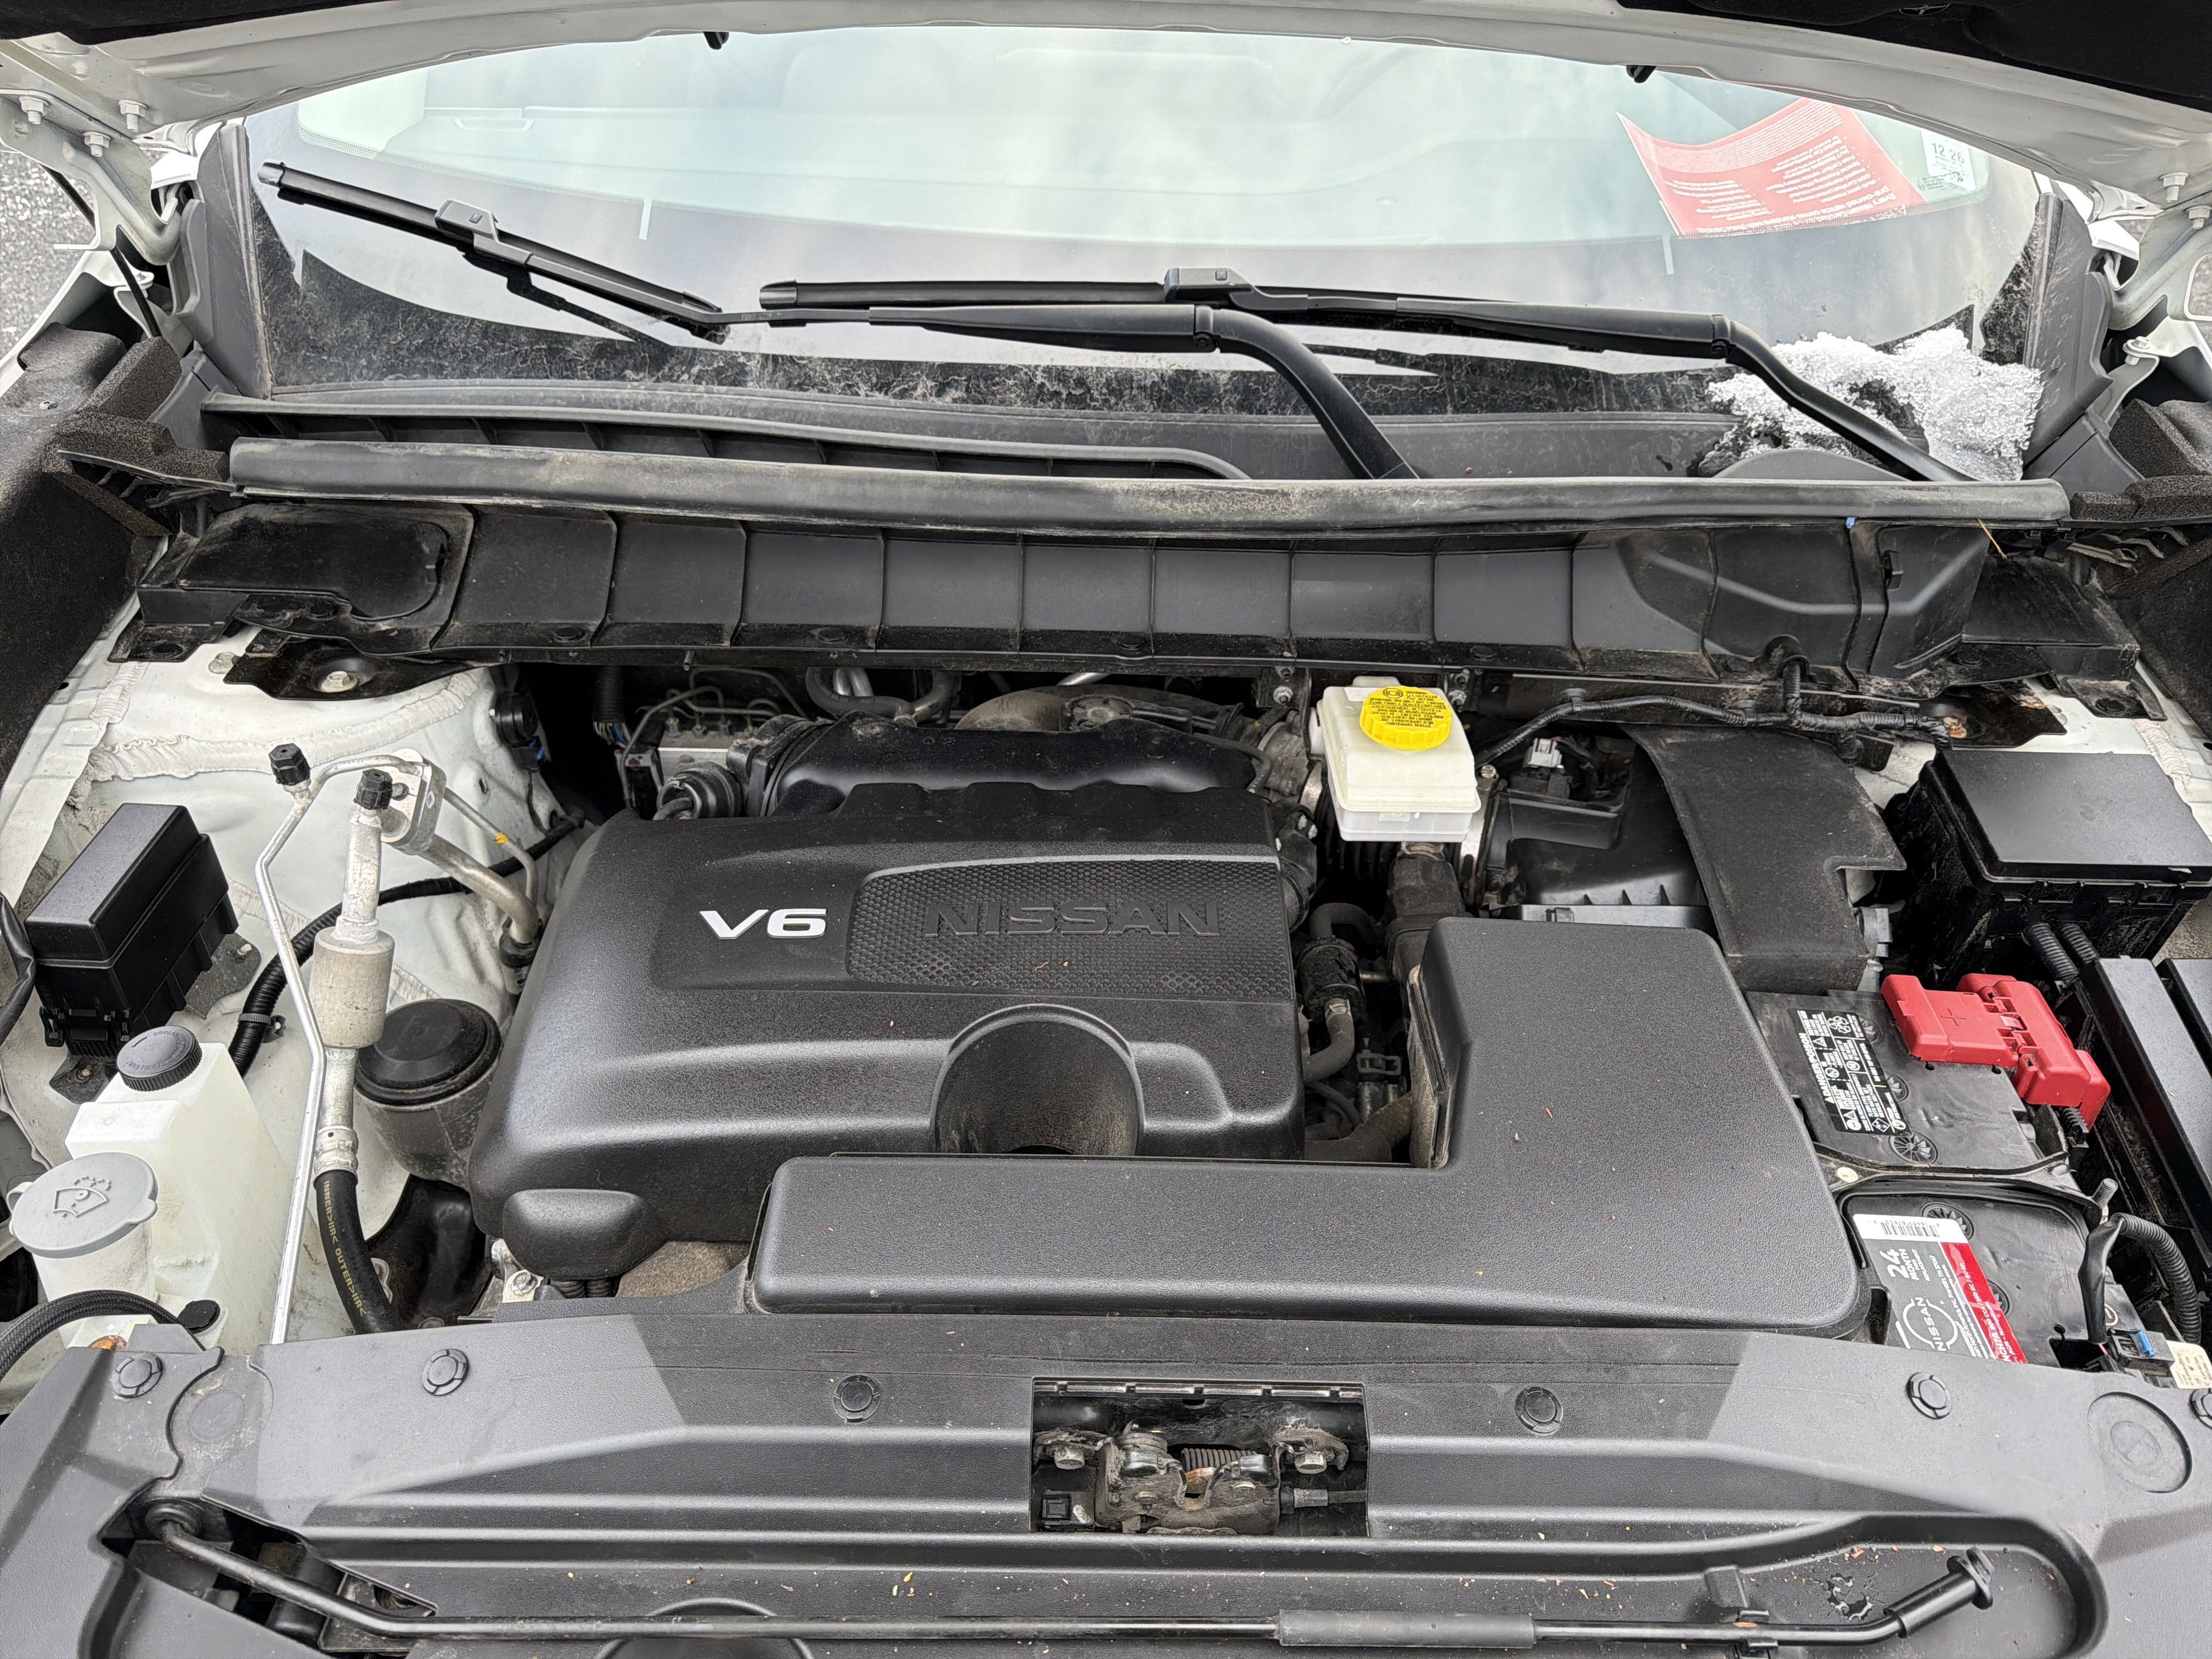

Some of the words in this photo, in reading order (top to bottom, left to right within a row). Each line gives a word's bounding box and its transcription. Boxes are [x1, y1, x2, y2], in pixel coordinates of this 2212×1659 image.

[1932, 143, 1945, 156] 12
[1949, 149, 1963, 163] 26
[699, 909, 827, 940] V6
[924, 900, 1221, 938] NISSAN
[1798, 1032, 1831, 1096] DANGER/POISON
[1878, 1249, 1910, 1278] 24
[1898, 1249, 1920, 1280] MONTH
[1915, 1297, 1946, 1351] NISSAN
